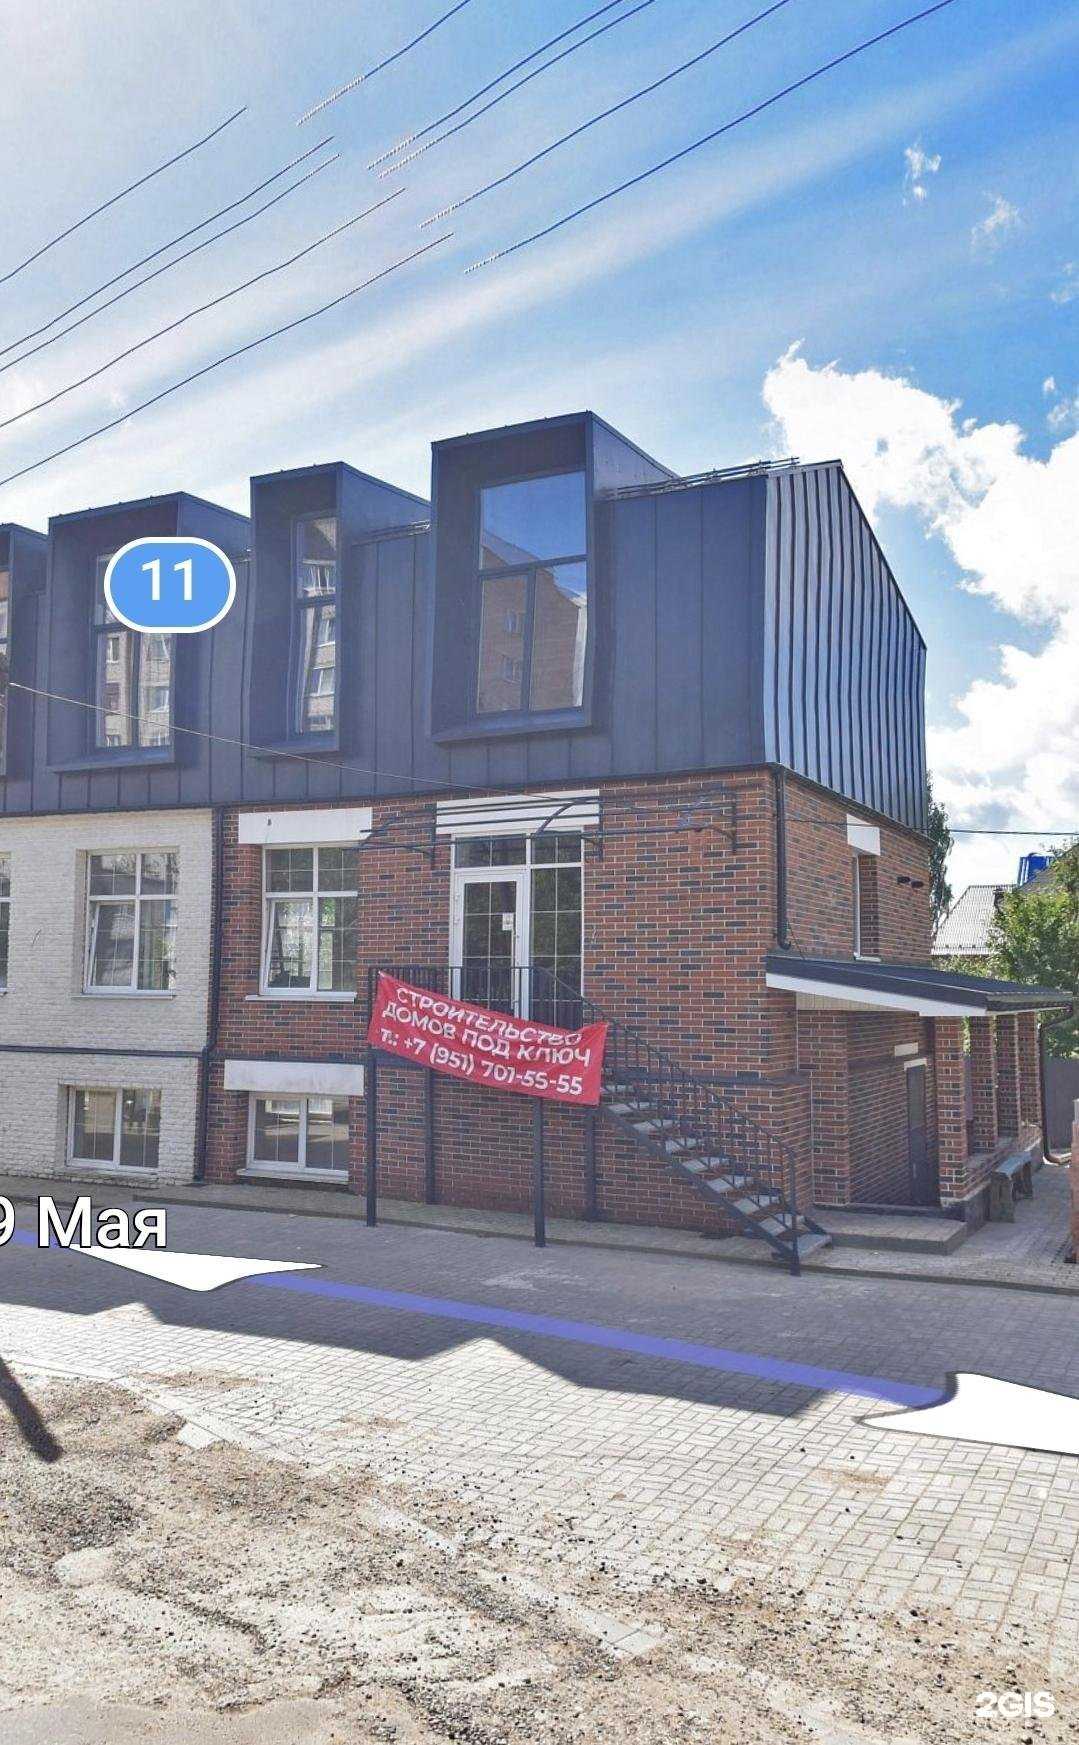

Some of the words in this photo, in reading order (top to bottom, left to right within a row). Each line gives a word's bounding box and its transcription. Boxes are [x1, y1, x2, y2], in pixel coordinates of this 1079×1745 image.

[381, 1002, 456, 1040] ДОМОВ
[462, 1028, 510, 1058] ПОД
[517, 1044, 591, 1067] КЛЮЧ
[396, 987, 582, 1046] СТРОИТЕЛЬСТВО
[403, 1038, 427, 1055] +7
[429, 1043, 475, 1076] (951)
[481, 1060, 583, 1096] 701-55-55
